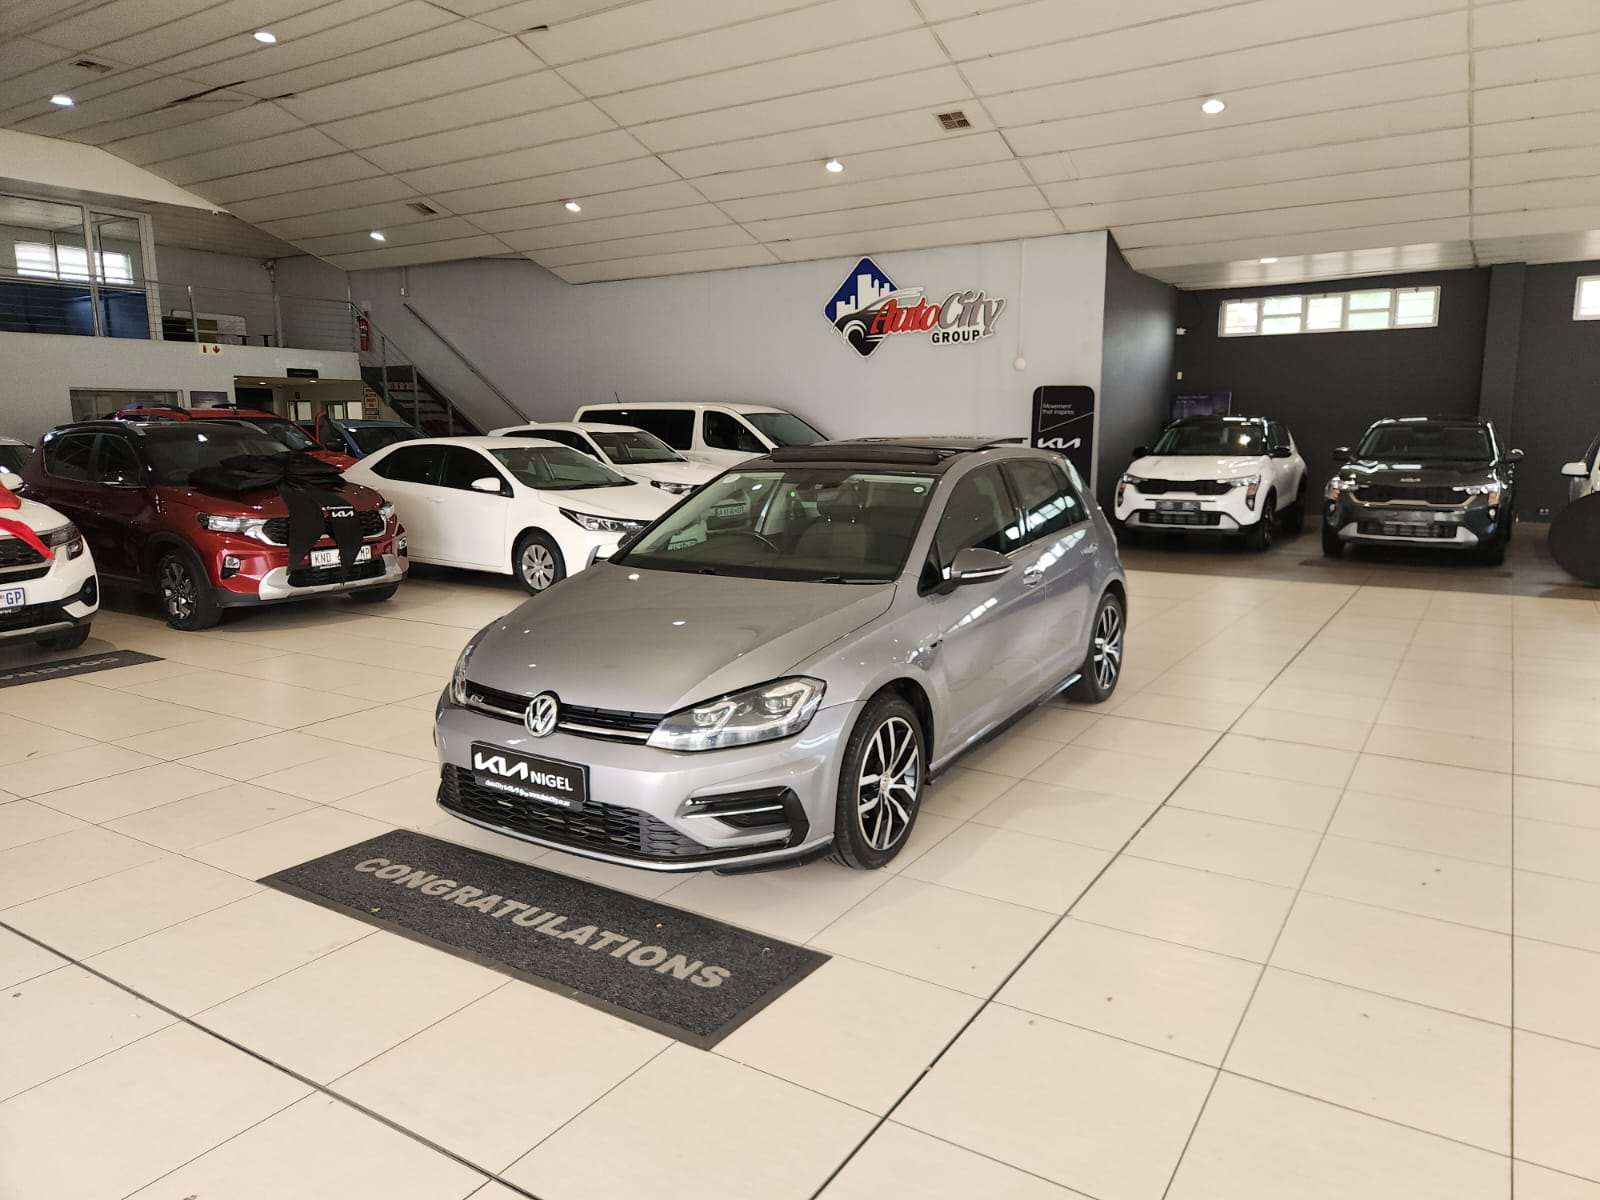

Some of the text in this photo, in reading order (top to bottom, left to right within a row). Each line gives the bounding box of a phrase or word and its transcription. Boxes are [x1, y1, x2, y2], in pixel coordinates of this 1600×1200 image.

[931, 329, 981, 344] GROUP
[1037, 437, 1081, 449] KIA
[6, 591, 22, 605] GP
[473, 751, 574, 792] KIA NIGEL
[354, 857, 732, 988] CONGRATULATIONS
